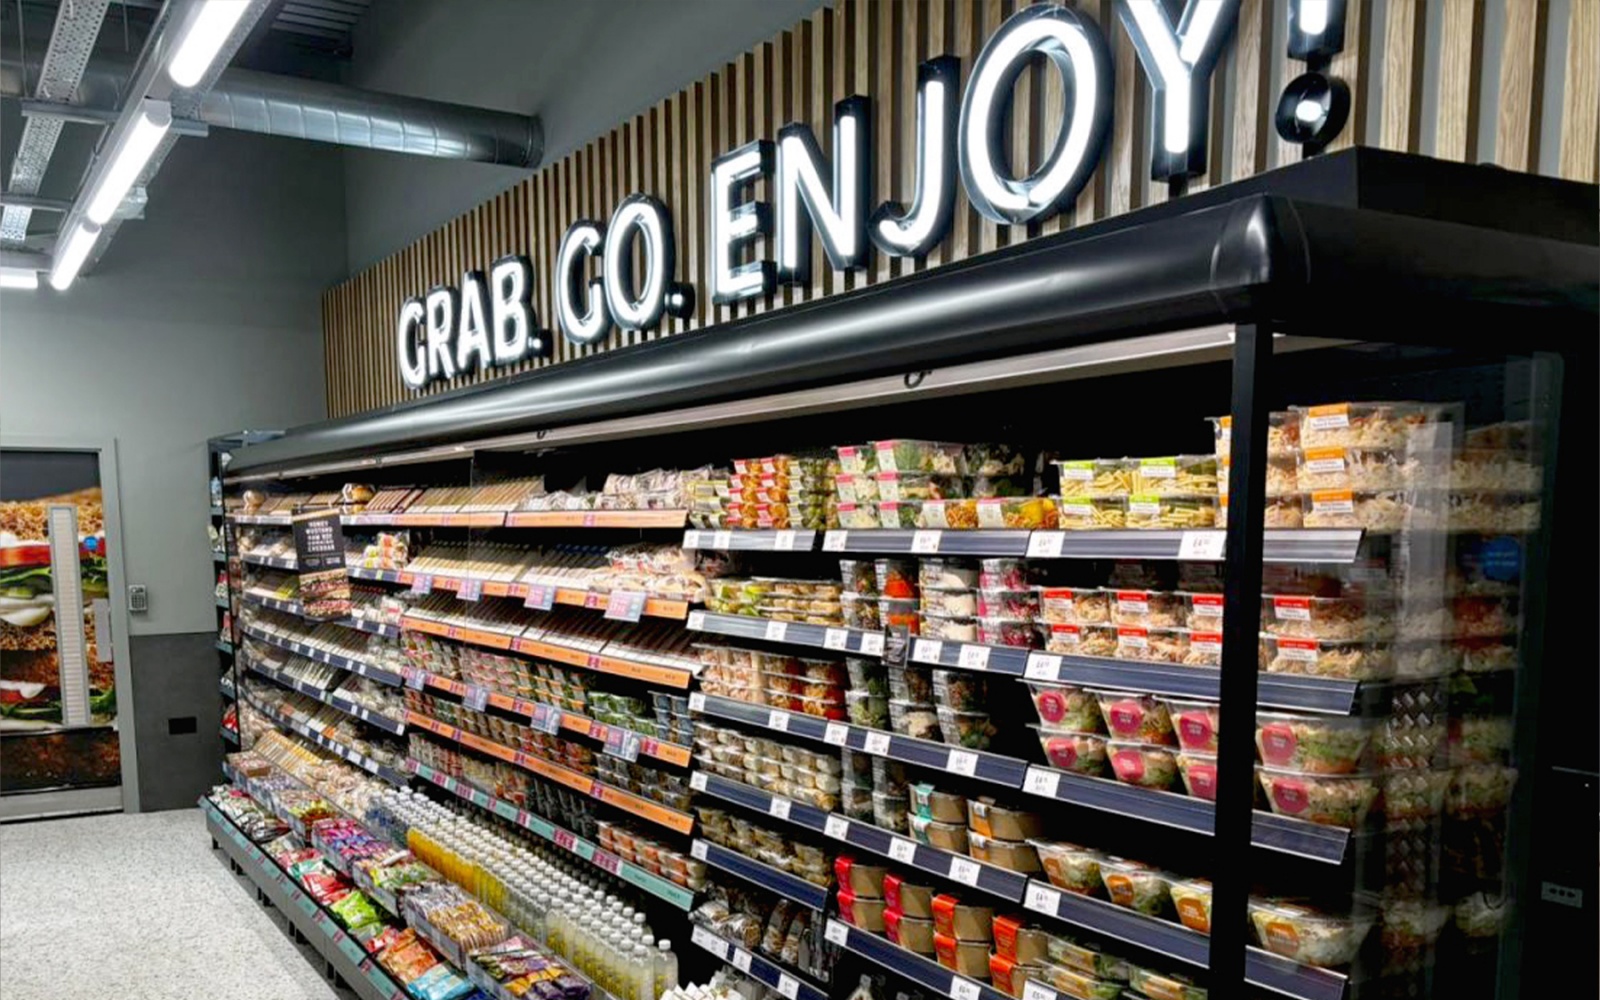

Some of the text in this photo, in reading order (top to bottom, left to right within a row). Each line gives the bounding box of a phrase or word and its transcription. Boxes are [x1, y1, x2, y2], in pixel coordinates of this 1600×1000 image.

[398, 0, 1348, 389] GRAB. GO. ENJOY!
